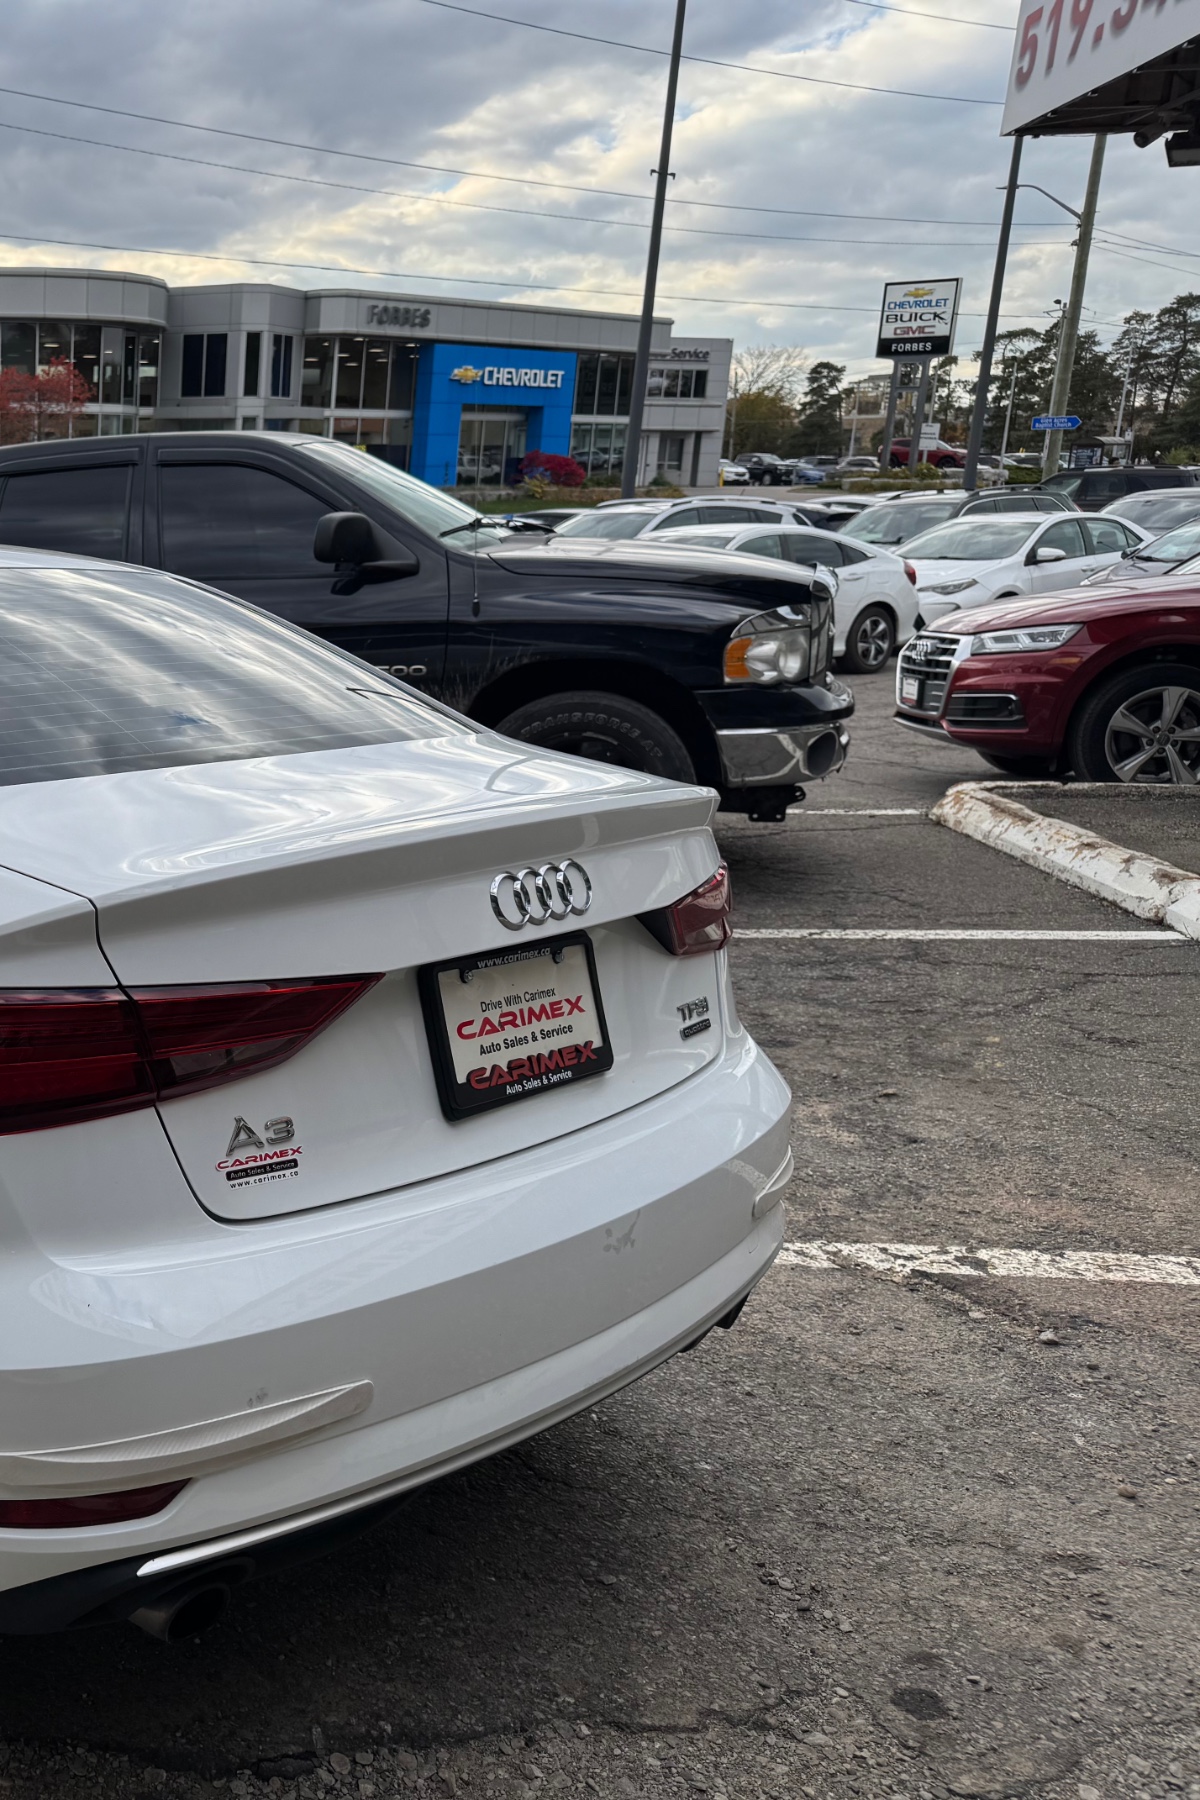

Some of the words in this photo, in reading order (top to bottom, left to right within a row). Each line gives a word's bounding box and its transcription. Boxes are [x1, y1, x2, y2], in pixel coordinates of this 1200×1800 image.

[887, 298, 949, 310] CHEVROLET
[367, 304, 431, 328] FORBES
[885, 311, 947, 324] BUICK
[893, 325, 936, 336] GMC
[671, 347, 710, 359] Service
[891, 342, 932, 352] FORBES
[483, 366, 565, 389] CHEVROLET
[520, 711, 641, 739] TRANSFORCE
[477, 947, 551, 969] www.carimex.ca
[480, 1000, 503, 1013] Drive
[503, 993, 522, 1006] With
[524, 987, 556, 1002] Carimex
[456, 995, 586, 1040] CARIMEX
[683, 1019, 711, 1038] quattro
[479, 1040, 502, 1056] Auto
[503, 1034, 529, 1050] Sales
[530, 1030, 539, 1042] &
[540, 1023, 573, 1041] Service
[467, 1040, 598, 1090] CARIMEX
[506, 1081, 523, 1095] Auto
[524, 1077, 542, 1090] Sales
[543, 1075, 549, 1085] &
[549, 1069, 573, 1083] Service
[225, 1115, 296, 1157] A3
[217, 1146, 303, 1170] CARIMEX
[229, 1170, 299, 1189] www.carimex.ca
[230, 1171, 246, 1179] Auto
[247, 1168, 264, 1176] Sales
[272, 1162, 295, 1171] Service
